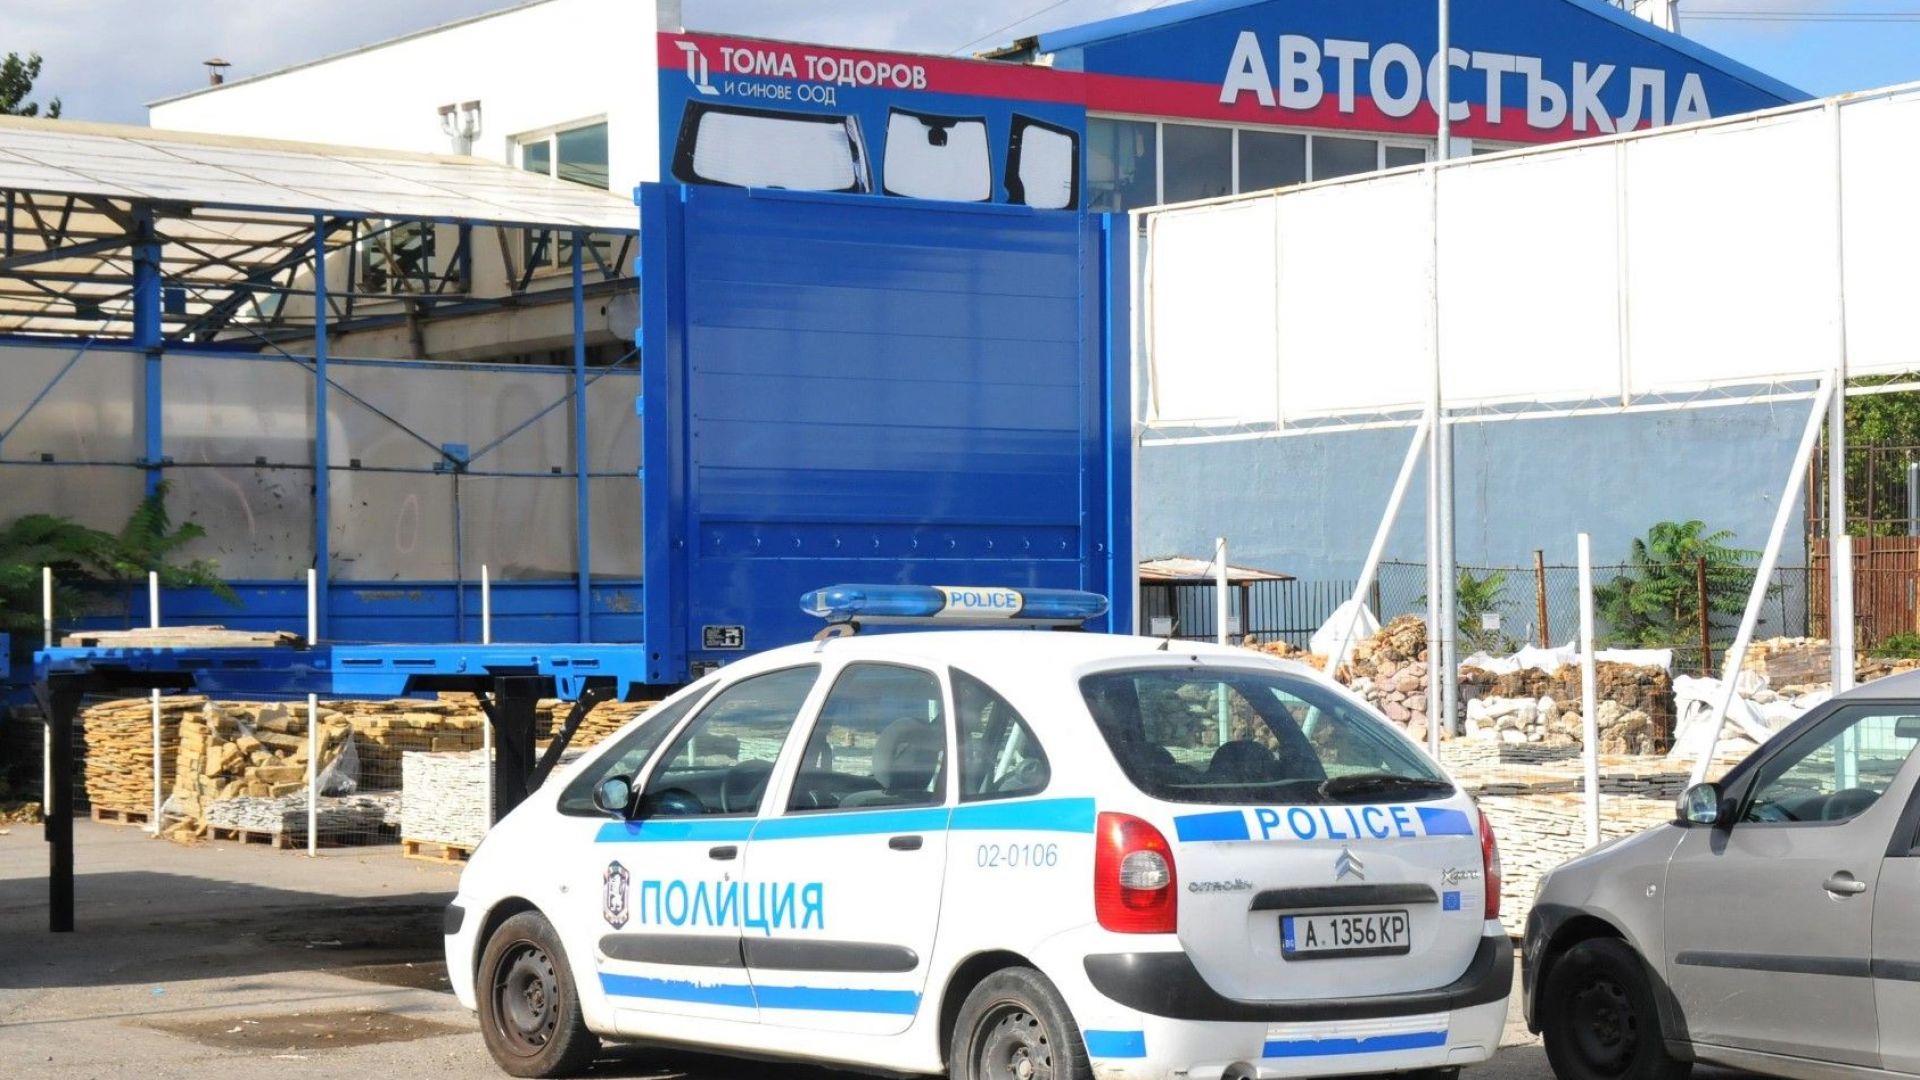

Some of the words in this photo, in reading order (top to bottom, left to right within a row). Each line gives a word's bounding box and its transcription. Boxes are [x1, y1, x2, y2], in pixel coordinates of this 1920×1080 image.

[720, 47, 798, 78] ТОМА
[804, 55, 927, 89] ТОДОРОВ
[1219, 31, 1712, 133] АВТОСТЪКЛА
[724, 81, 735, 95] И
[737, 82, 793, 101] СИНОВЕ
[797, 84, 837, 106] ООД
[951, 592, 1017, 608] POLICE
[1255, 806, 1417, 841] POLICE
[977, 843, 1059, 868] 02-0106
[640, 879, 825, 937] ПОЛИЦИЯ
